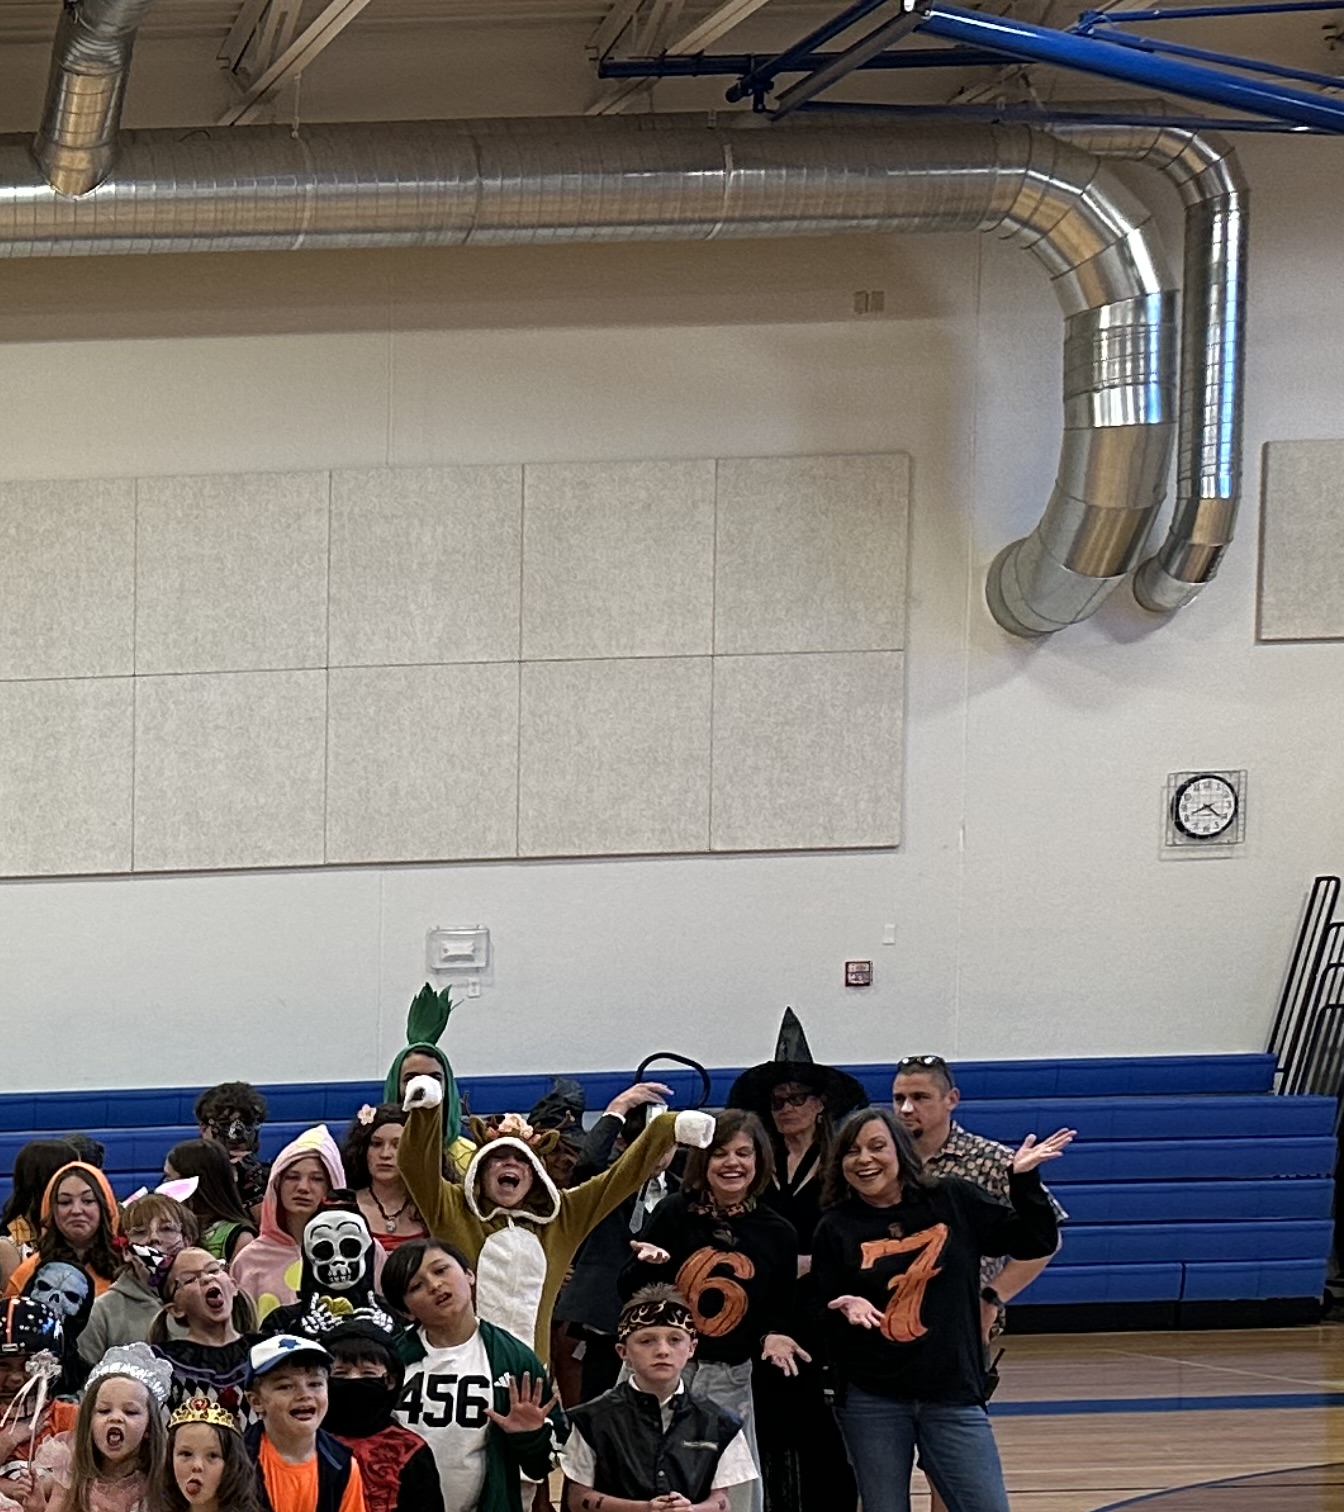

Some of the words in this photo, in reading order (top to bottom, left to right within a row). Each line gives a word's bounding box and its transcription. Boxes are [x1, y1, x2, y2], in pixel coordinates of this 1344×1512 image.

[675, 1246, 755, 1337] 6
[861, 1223, 948, 1341] 7
[395, 1371, 490, 1428] 456
